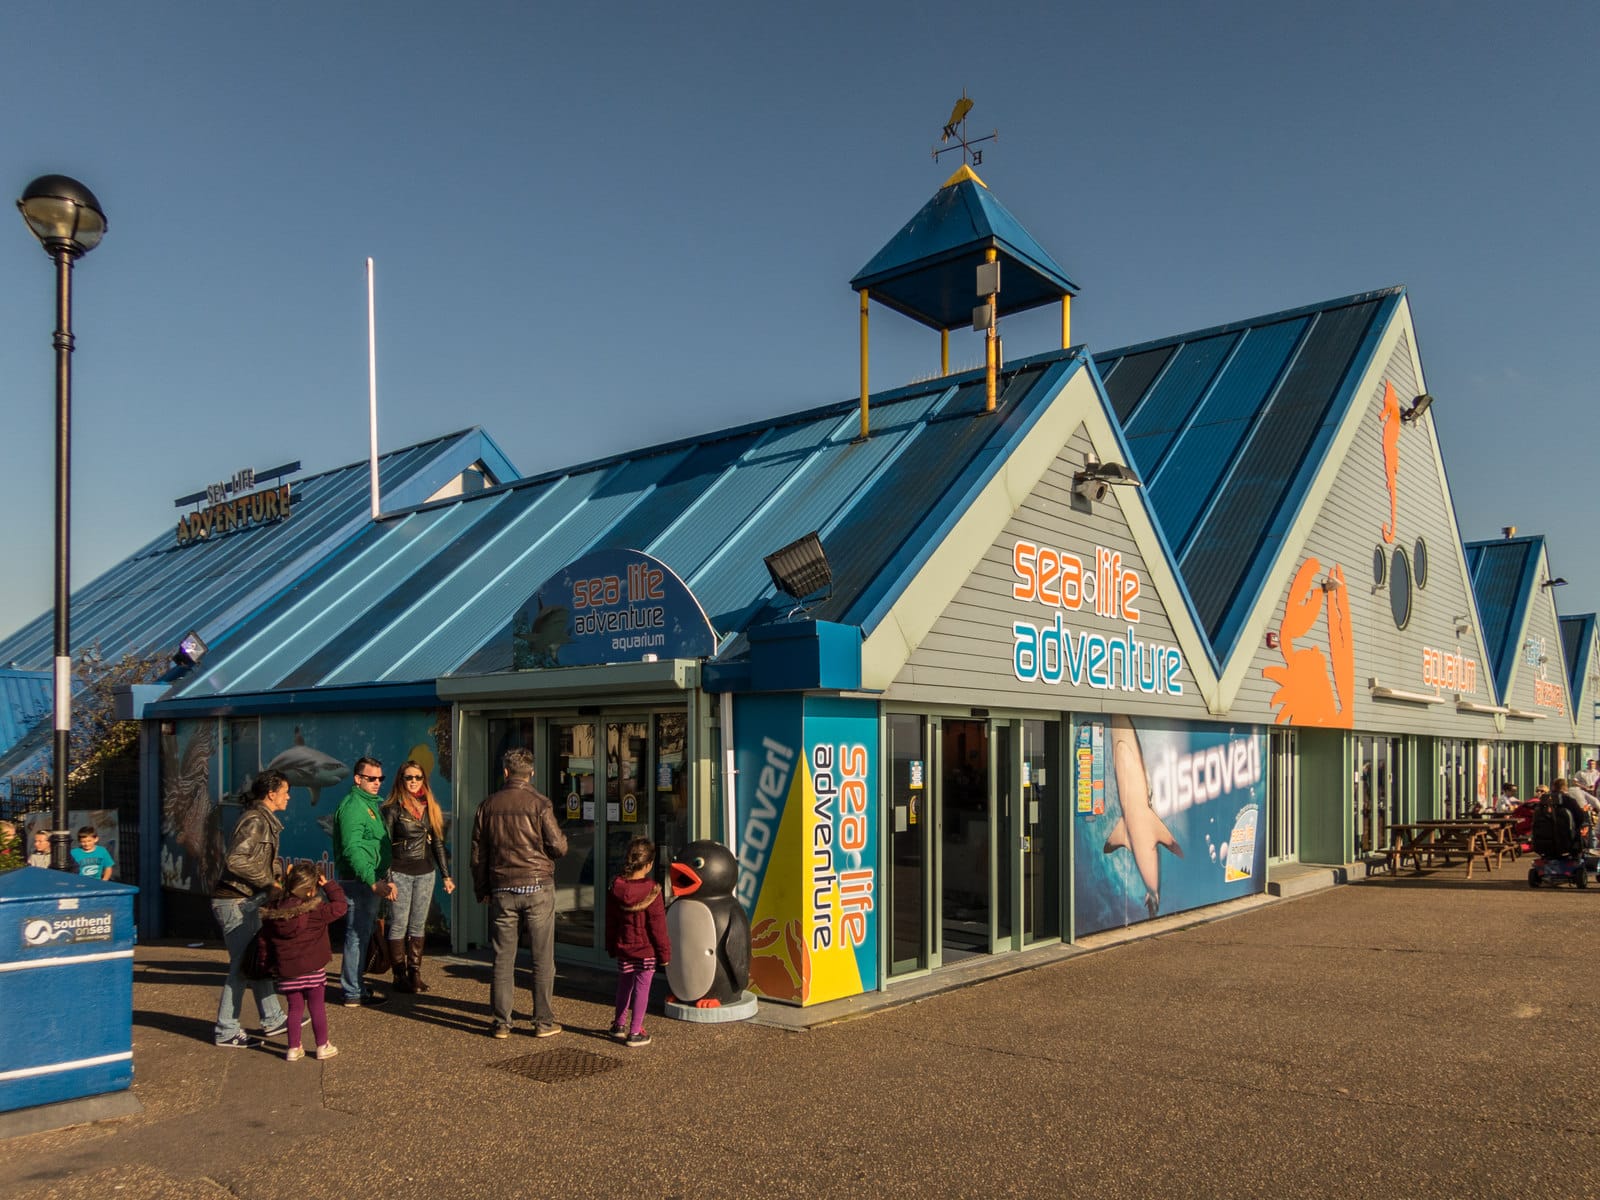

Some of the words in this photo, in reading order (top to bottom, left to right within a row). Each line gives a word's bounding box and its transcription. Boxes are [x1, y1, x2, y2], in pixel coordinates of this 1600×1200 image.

[177, 482, 291, 544] ADVENTURE
[206, 480, 227, 504] SEA
[232, 467, 255, 495] LIFE
[573, 578, 620, 609] sea
[627, 562, 664, 602] life
[1013, 540, 1083, 611] sea
[1095, 545, 1140, 623] life
[575, 603, 664, 635] adventure
[612, 632, 664, 651] aquarium
[1013, 611, 1183, 695] adventure
[1423, 646, 1476, 696] aquarium
[838, 743, 868, 851] sea
[1153, 725, 1261, 818] discover!
[737, 736, 794, 909] iscover!
[812, 744, 838, 950] adventure
[53, 913, 111, 929] southend
[838, 868, 874, 949] life
